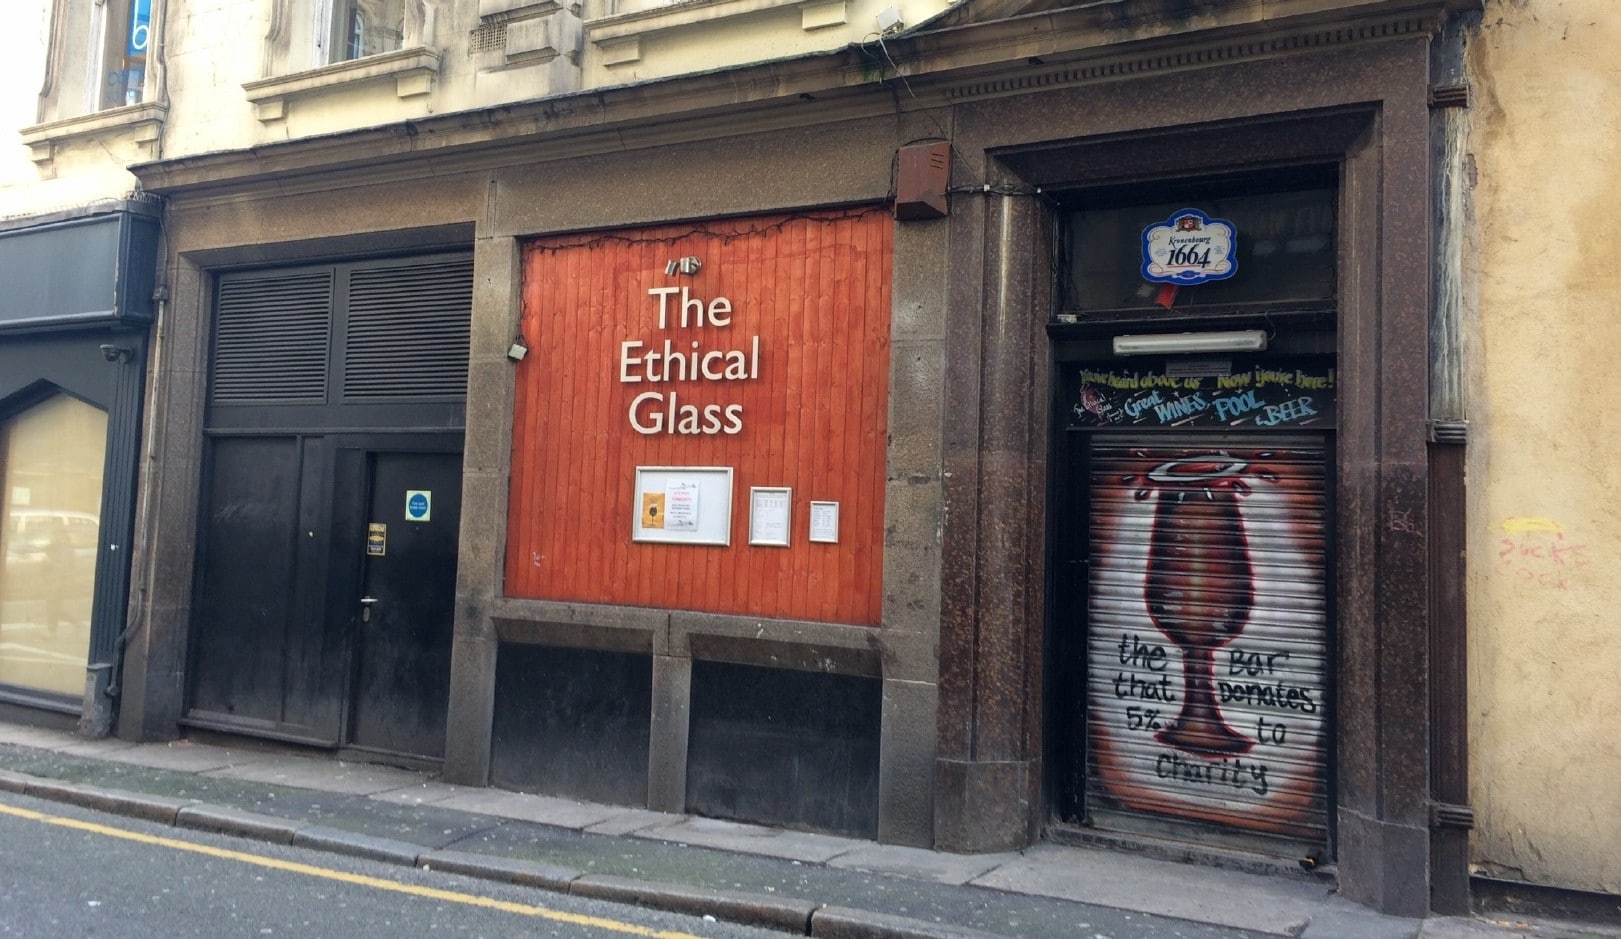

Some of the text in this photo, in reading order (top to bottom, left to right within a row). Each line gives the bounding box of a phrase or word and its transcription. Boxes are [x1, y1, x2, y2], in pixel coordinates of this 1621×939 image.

[1167, 244, 1211, 268] 1664
[1168, 236, 1211, 247] Kronenbourg
[648, 286, 732, 329] The
[620, 336, 759, 383] Ethical
[628, 392, 743, 434] Glass
[1124, 390, 1164, 419] Great
[1212, 390, 1266, 422] POOL
[1263, 396, 1318, 426] BEER
[1118, 633, 1168, 672] the
[1112, 672, 1177, 702] that
[1126, 706, 1287, 745] 5% to
